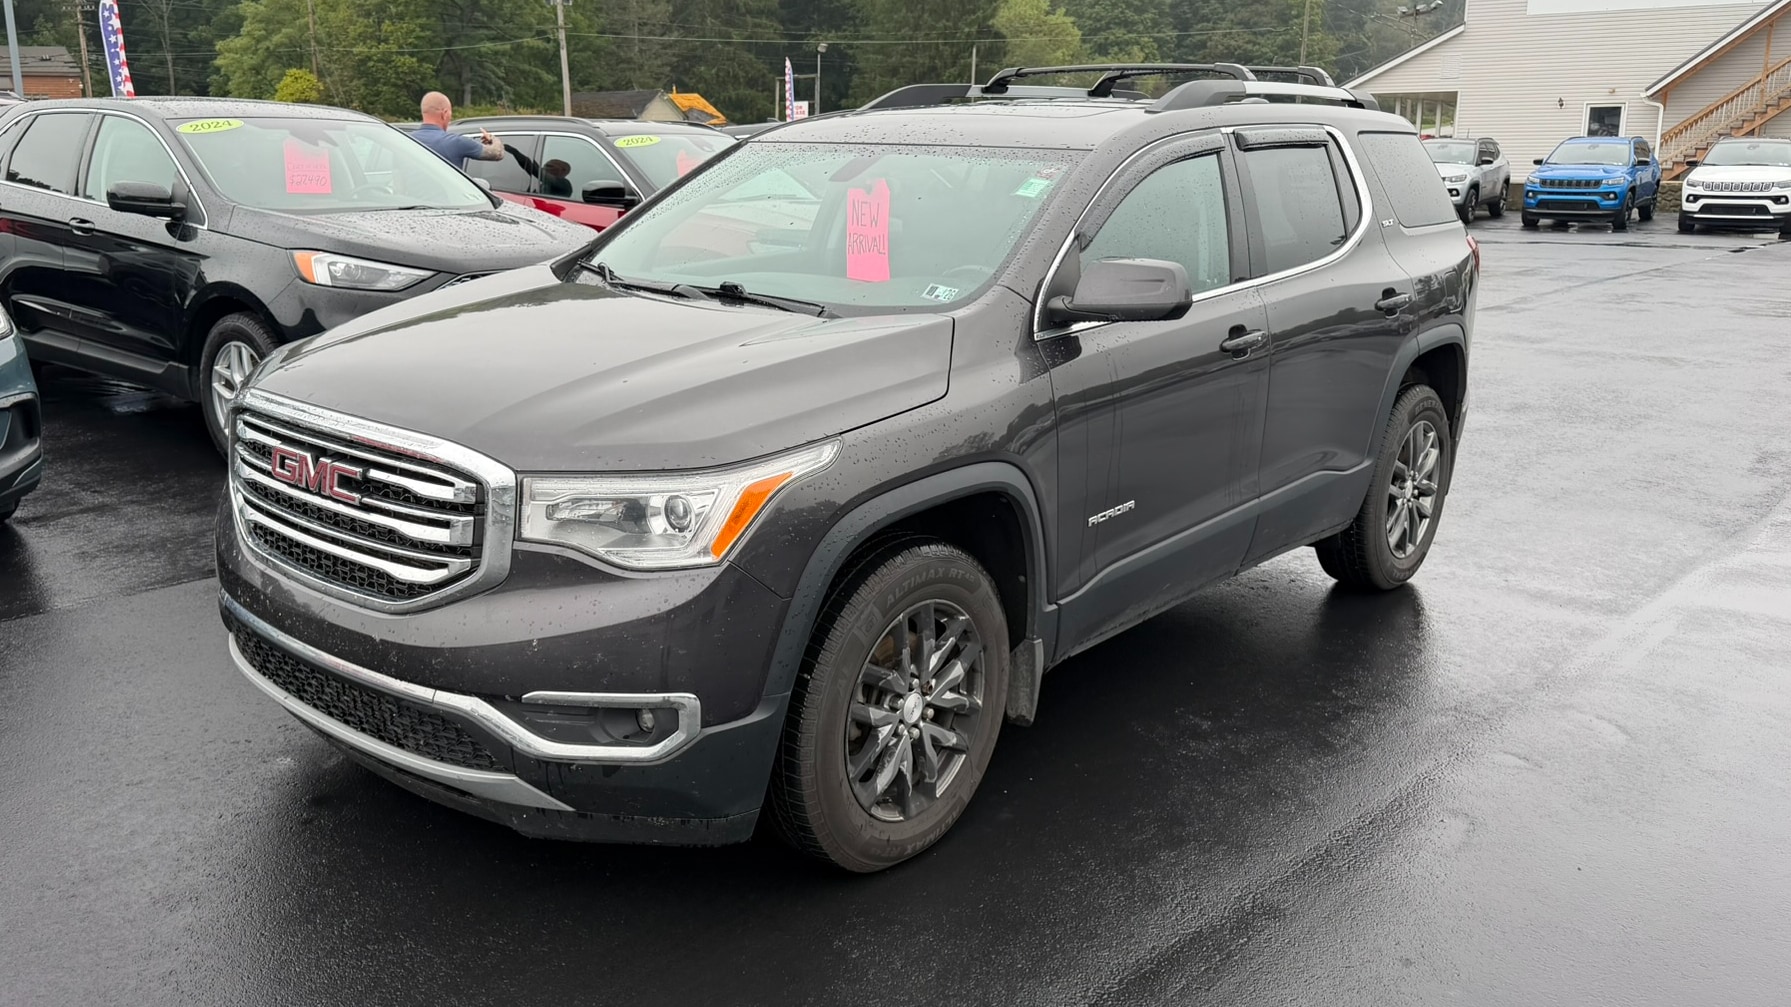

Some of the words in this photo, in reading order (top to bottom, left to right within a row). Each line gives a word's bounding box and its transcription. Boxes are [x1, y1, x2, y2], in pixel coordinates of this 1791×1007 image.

[190, 120, 232, 132] 2024
[623, 136, 654, 146] 2024
[851, 199, 880, 228] NEW
[847, 232, 887, 256] ARRIVAL!
[271, 445, 363, 506] GMC
[1087, 499, 1136, 528] ACADIA
[886, 567, 946, 609] ALTIMAX
